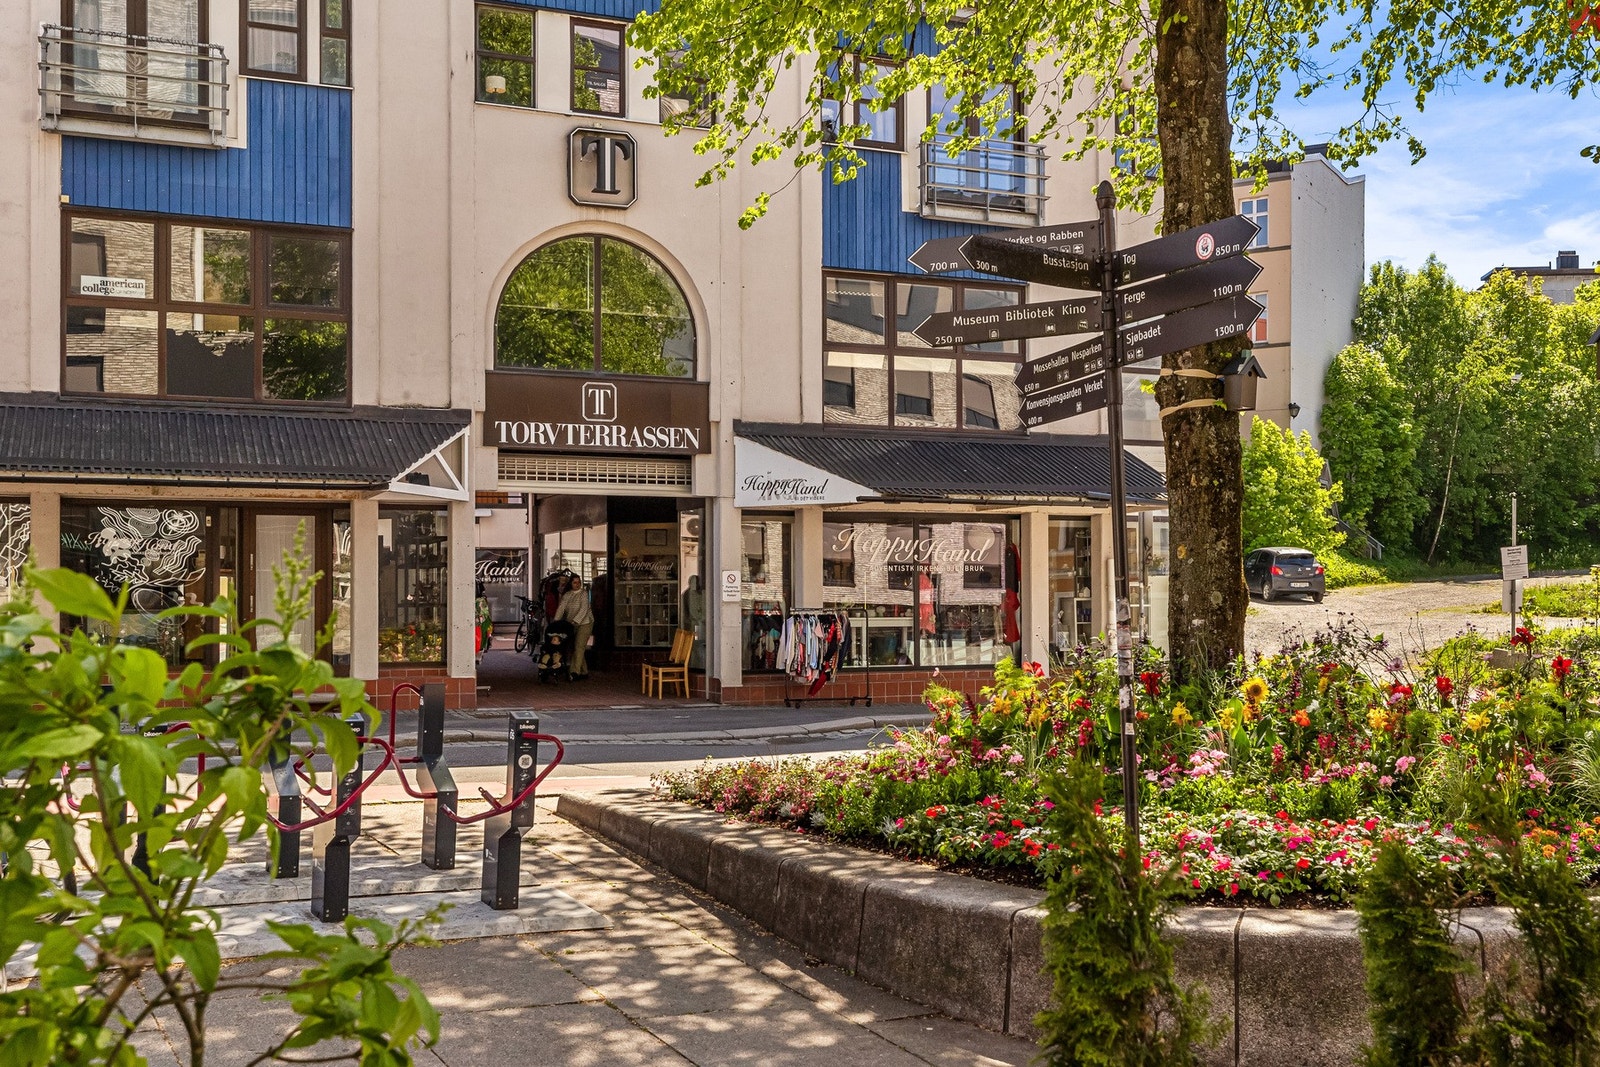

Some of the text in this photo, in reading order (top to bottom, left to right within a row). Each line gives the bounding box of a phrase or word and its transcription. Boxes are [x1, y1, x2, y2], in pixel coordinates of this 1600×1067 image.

[1036, 235, 1047, 244] og
[1050, 229, 1084, 241] Rabben
[1215, 243, 1240, 256] 850 m
[930, 261, 958, 271] 700 m
[975, 260, 998, 273] 300 m
[1043, 254, 1089, 272] Busstasjon
[1122, 253, 1137, 265] Tog
[82, 283, 115, 295] college
[100, 279, 144, 289] american
[1212, 283, 1242, 298] 1100 m
[1123, 290, 1146, 304] Ferge
[953, 304, 1086, 327] Museum Bibliotek Kino
[1126, 324, 1162, 346] Sjøbadet
[1214, 322, 1244, 337] 1300 m
[935, 335, 952, 345] 250
[1033, 343, 1102, 374] Mossehallen Nesparken
[1024, 382, 1040, 393] 650 m
[1026, 379, 1104, 411] Konvensjonsgaarden Verket
[494, 420, 701, 450] TORVTERRASSEN
[741, 474, 829, 497] Happy Hand
[832, 527, 990, 563] Happy Hand
[475, 560, 524, 576] Hand
